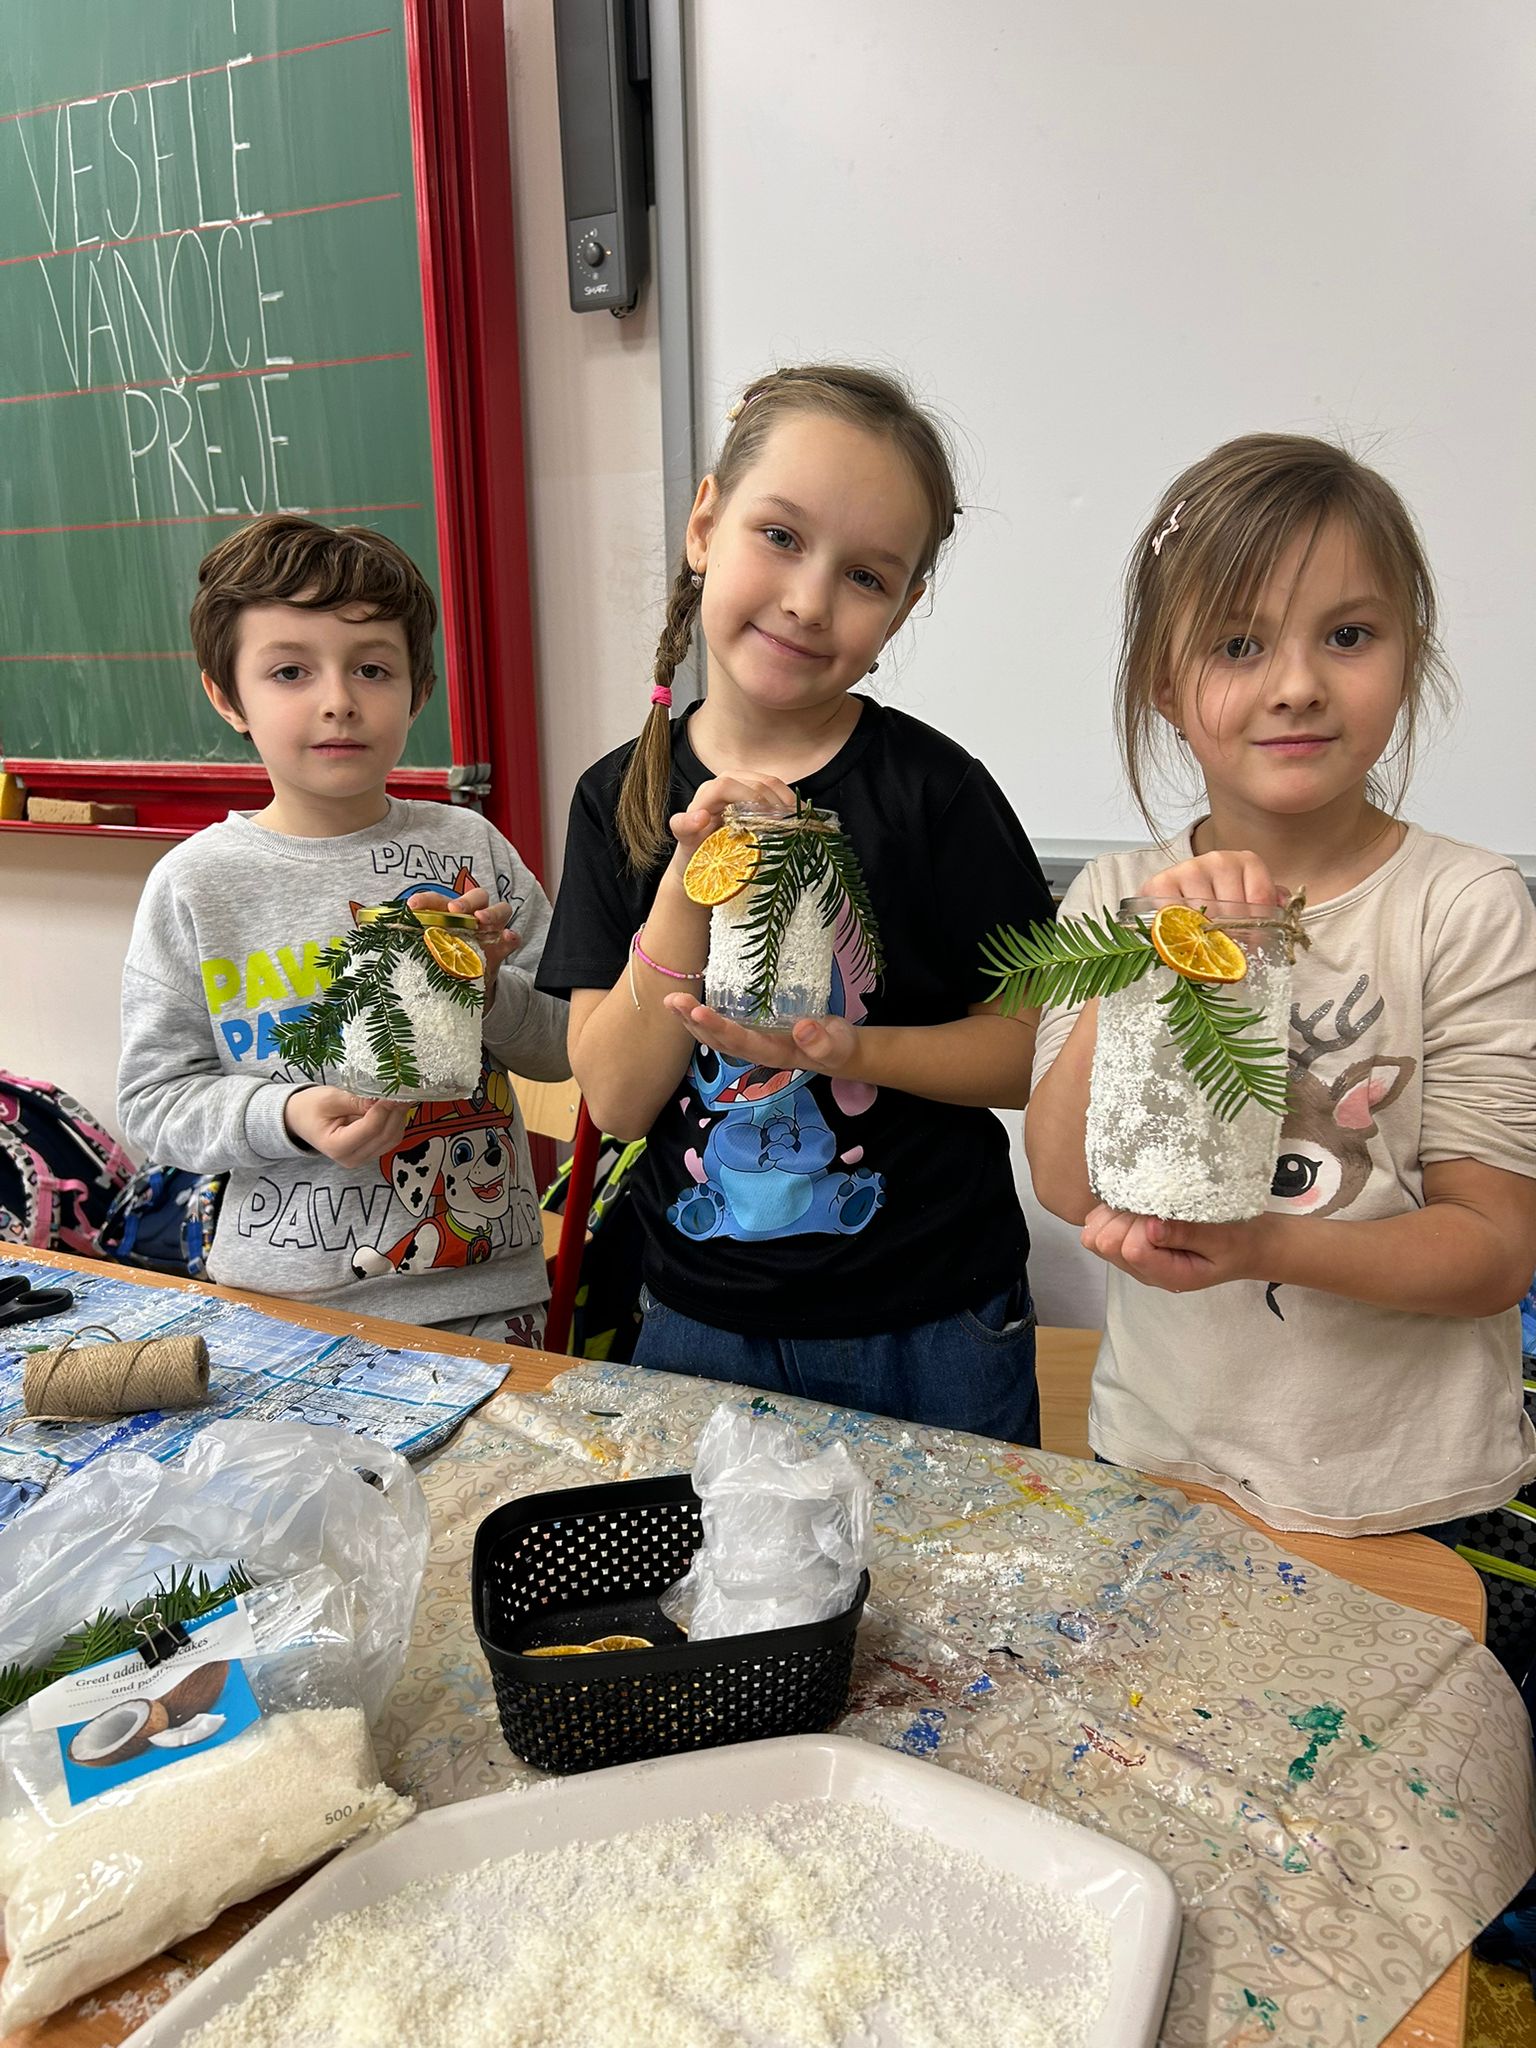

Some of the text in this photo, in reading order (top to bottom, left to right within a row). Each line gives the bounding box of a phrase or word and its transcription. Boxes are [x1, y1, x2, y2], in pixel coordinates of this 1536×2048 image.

[37, 220, 294, 393] VÁNOCE
[122, 372, 310, 521] PŘEJE
[371, 840, 474, 885] PAW
[200, 935, 349, 1015] PAW
[238, 1176, 395, 1252] PAW
[76, 1672, 110, 1687] Great
[178, 1637, 209, 1656] cakes
[111, 1682, 135, 1695] and
[325, 1805, 352, 1826] 500
